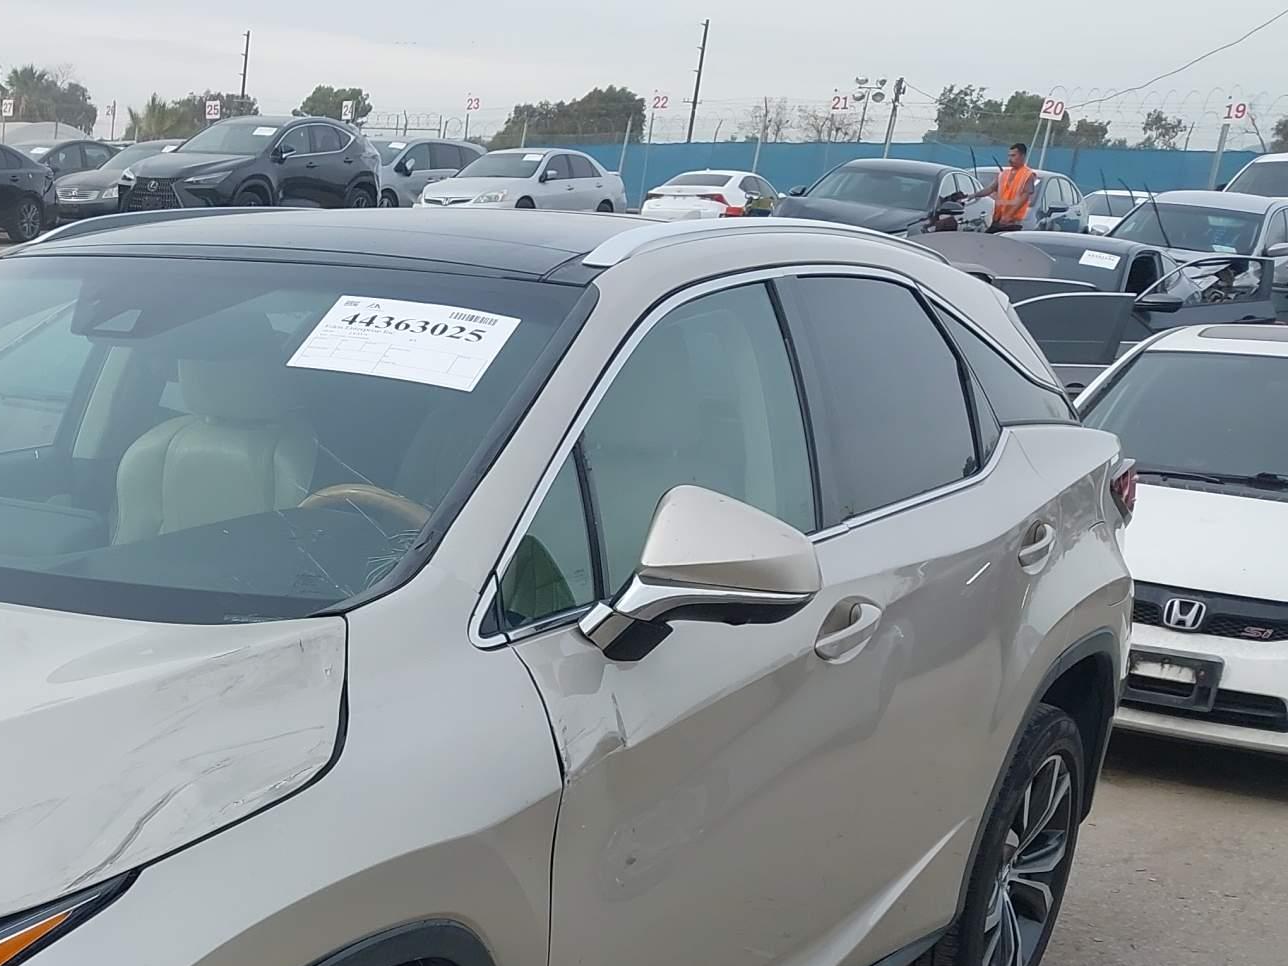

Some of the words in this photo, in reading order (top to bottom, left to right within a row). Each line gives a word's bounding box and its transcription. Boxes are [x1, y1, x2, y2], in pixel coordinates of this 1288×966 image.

[3, 102, 13, 114] 27
[466, 98, 480, 111] 23
[653, 96, 669, 109] 22
[832, 96, 849, 110] 21
[1043, 100, 1065, 116] 20
[207, 104, 219, 116] 25
[1224, 104, 1246, 119] 19
[341, 312, 487, 343] 44363025
